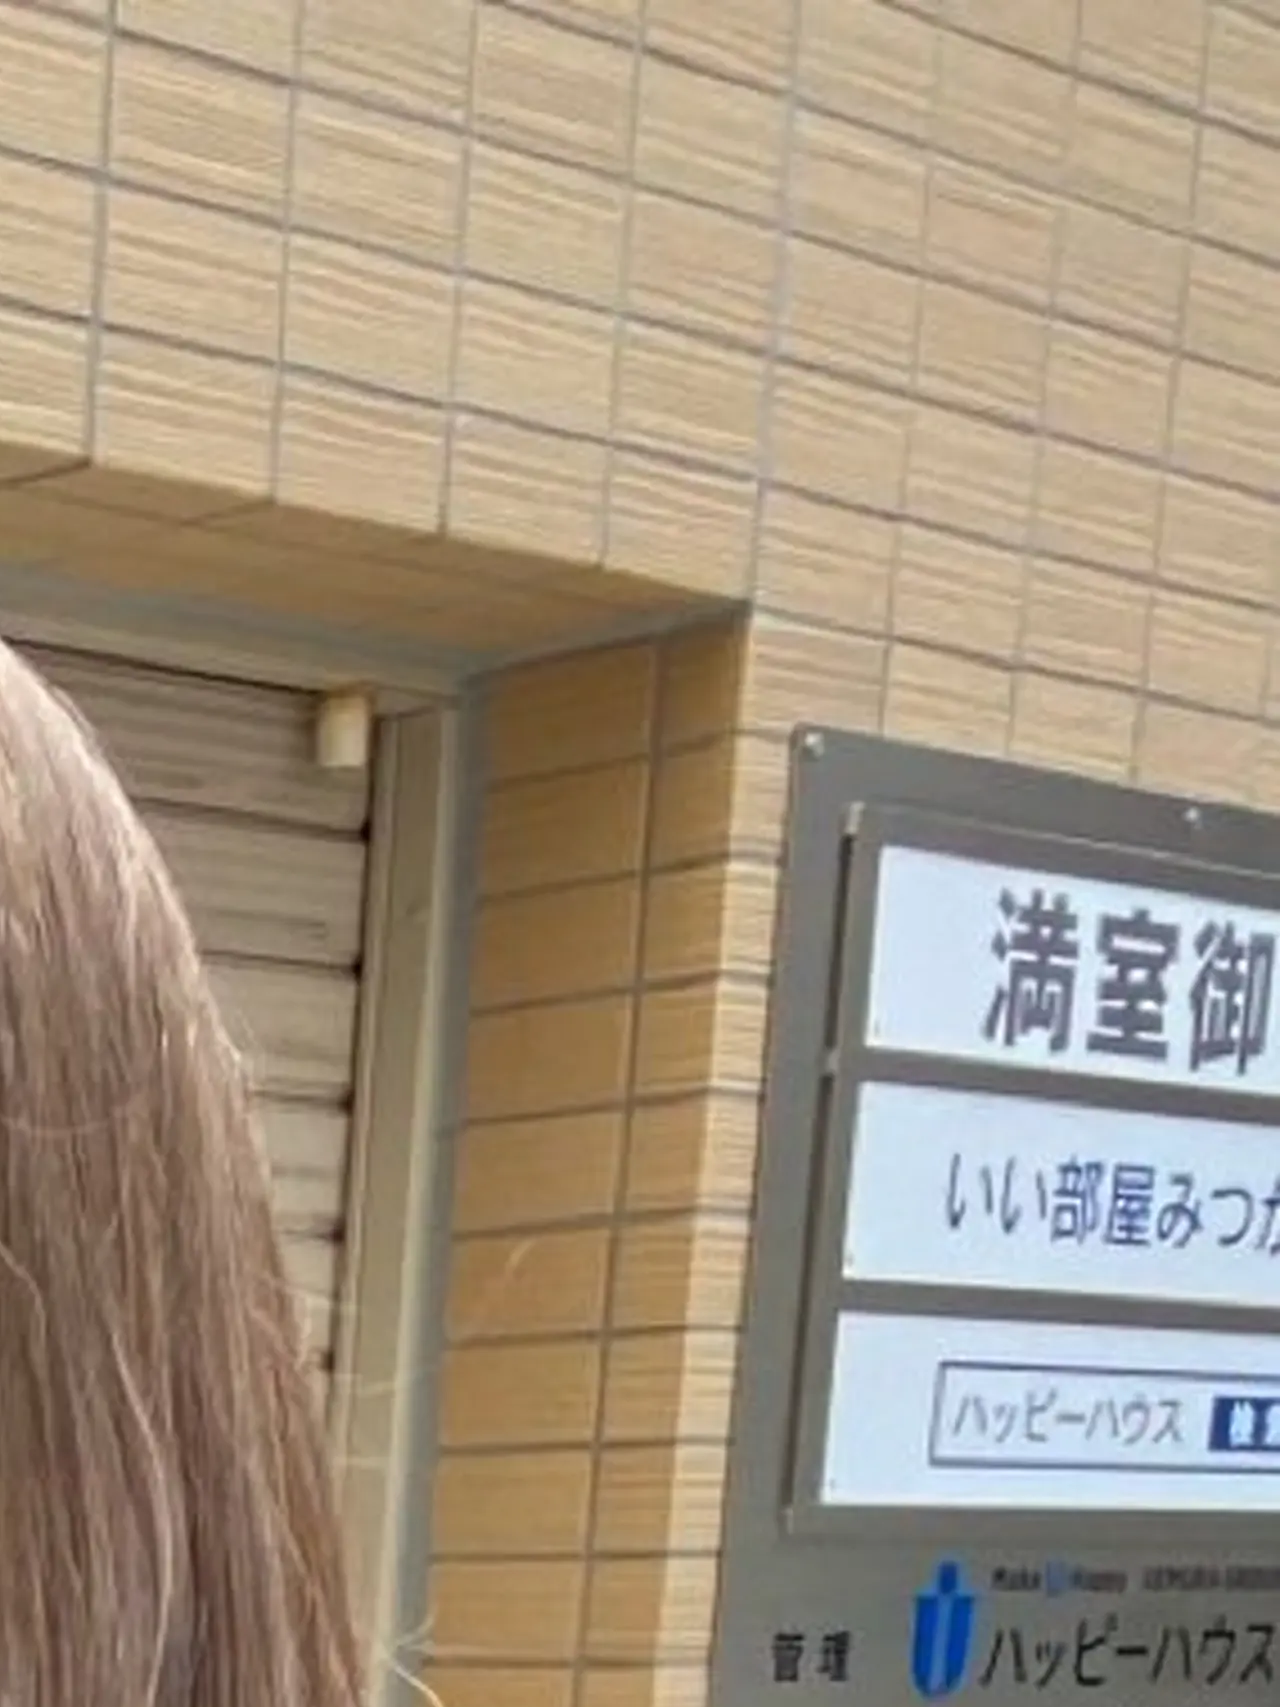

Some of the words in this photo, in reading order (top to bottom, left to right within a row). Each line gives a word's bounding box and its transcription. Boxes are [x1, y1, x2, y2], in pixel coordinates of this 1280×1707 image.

[980, 886, 1275, 1077] 満室御
[951, 1386, 1183, 1445] ハッピーハウス
[771, 1630, 851, 1683] 管理
[978, 1612, 1274, 1688] ハッピーハウス
